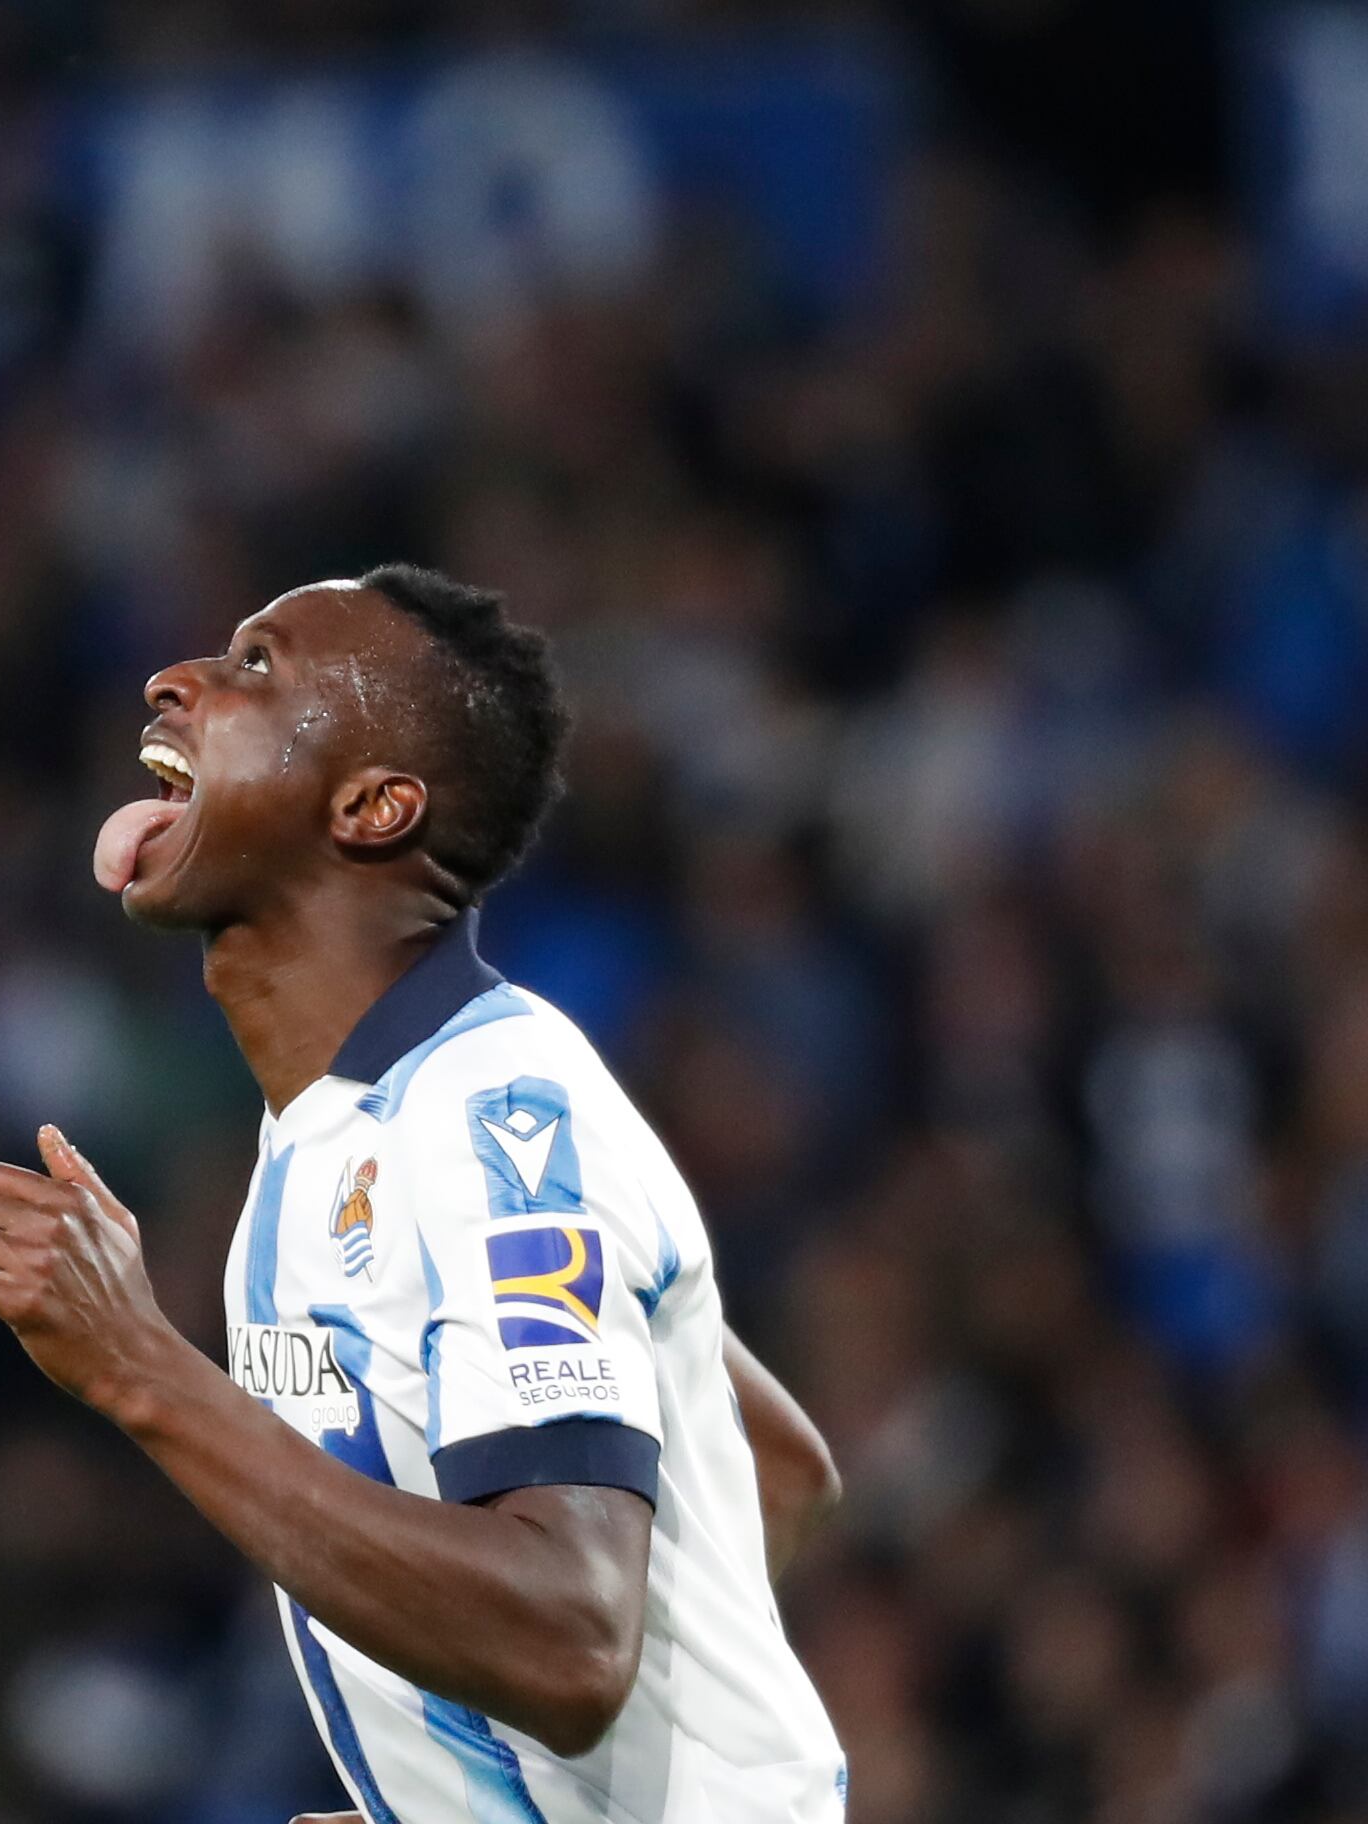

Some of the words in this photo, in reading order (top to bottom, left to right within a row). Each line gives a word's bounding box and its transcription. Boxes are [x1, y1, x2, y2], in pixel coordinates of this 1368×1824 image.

[228, 1326, 353, 1396] YASUDA
[509, 1359, 616, 1388] REALE
[519, 1385, 620, 1406] SEGUROS
[312, 1405, 357, 1434] group
